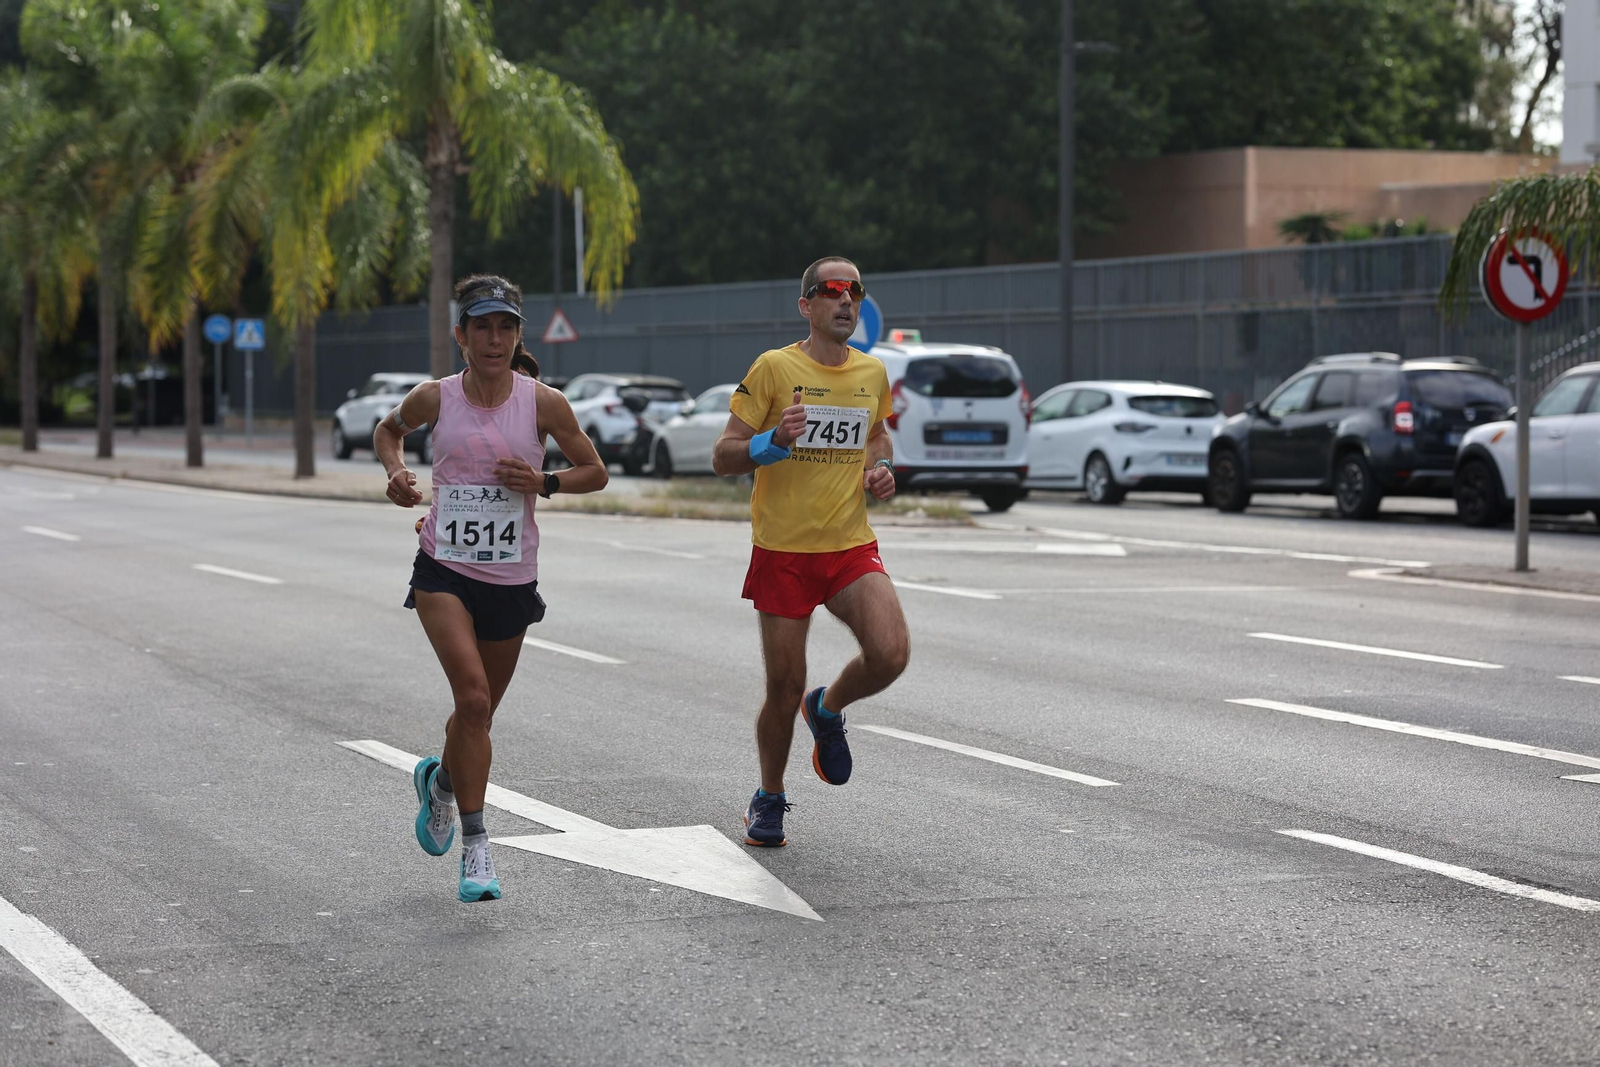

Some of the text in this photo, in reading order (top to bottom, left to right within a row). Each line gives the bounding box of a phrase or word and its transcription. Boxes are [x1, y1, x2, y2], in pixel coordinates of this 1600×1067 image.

[806, 420, 860, 444] 7451
[792, 448, 828, 456] ARRERA
[449, 489, 475, 502] 45
[445, 520, 516, 546] 1514
